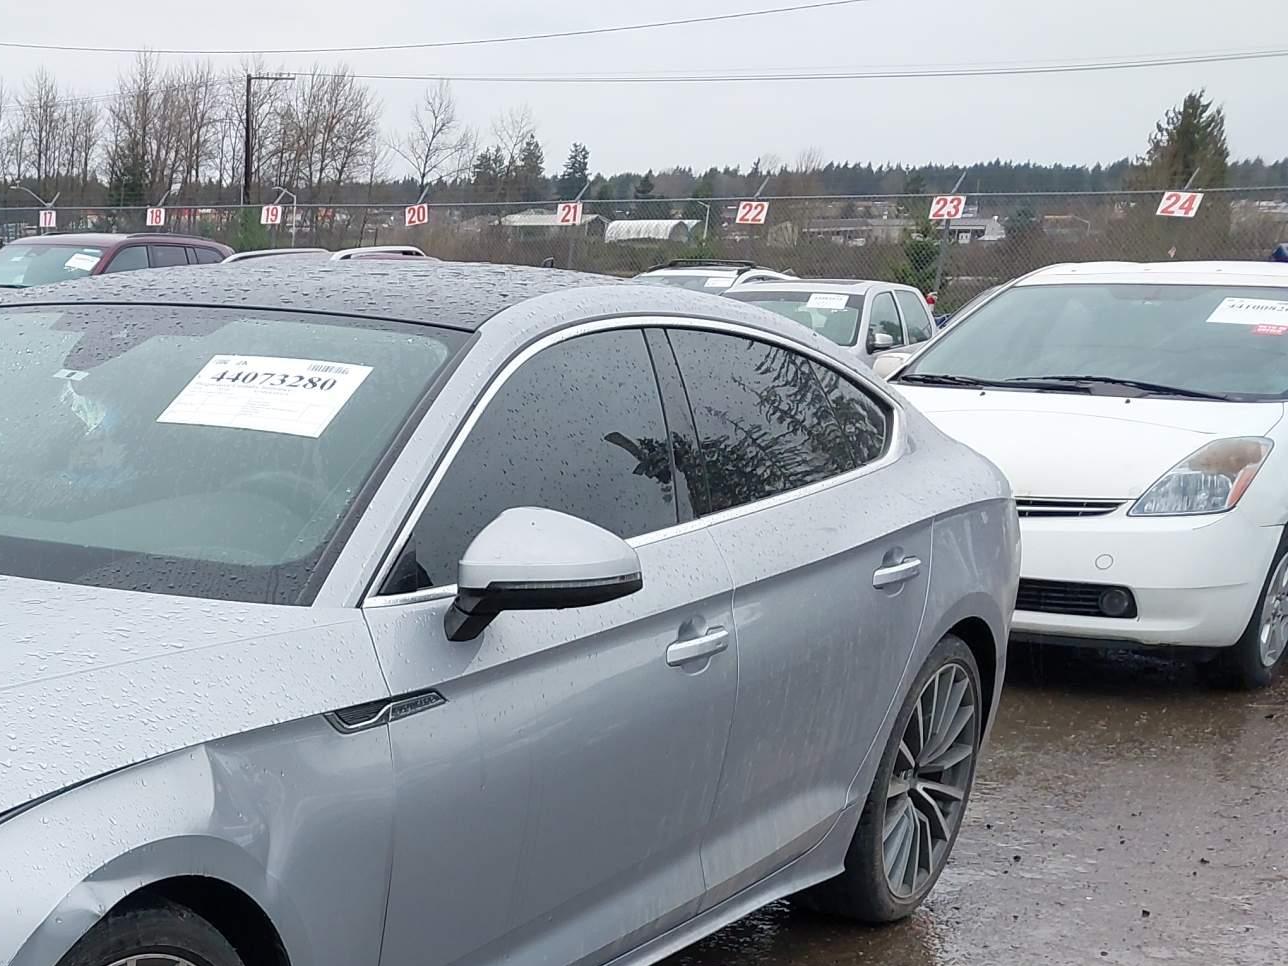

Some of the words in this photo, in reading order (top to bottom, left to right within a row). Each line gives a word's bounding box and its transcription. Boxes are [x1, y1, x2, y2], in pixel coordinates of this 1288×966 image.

[561, 205, 578, 222] 21
[739, 203, 764, 222] 22
[932, 197, 961, 217] 23
[1160, 194, 1197, 215] 24
[42, 212, 54, 225] 17
[150, 209, 162, 224] 18
[266, 207, 279, 222] 19
[407, 206, 426, 224] 20
[210, 369, 337, 391] 44073280
